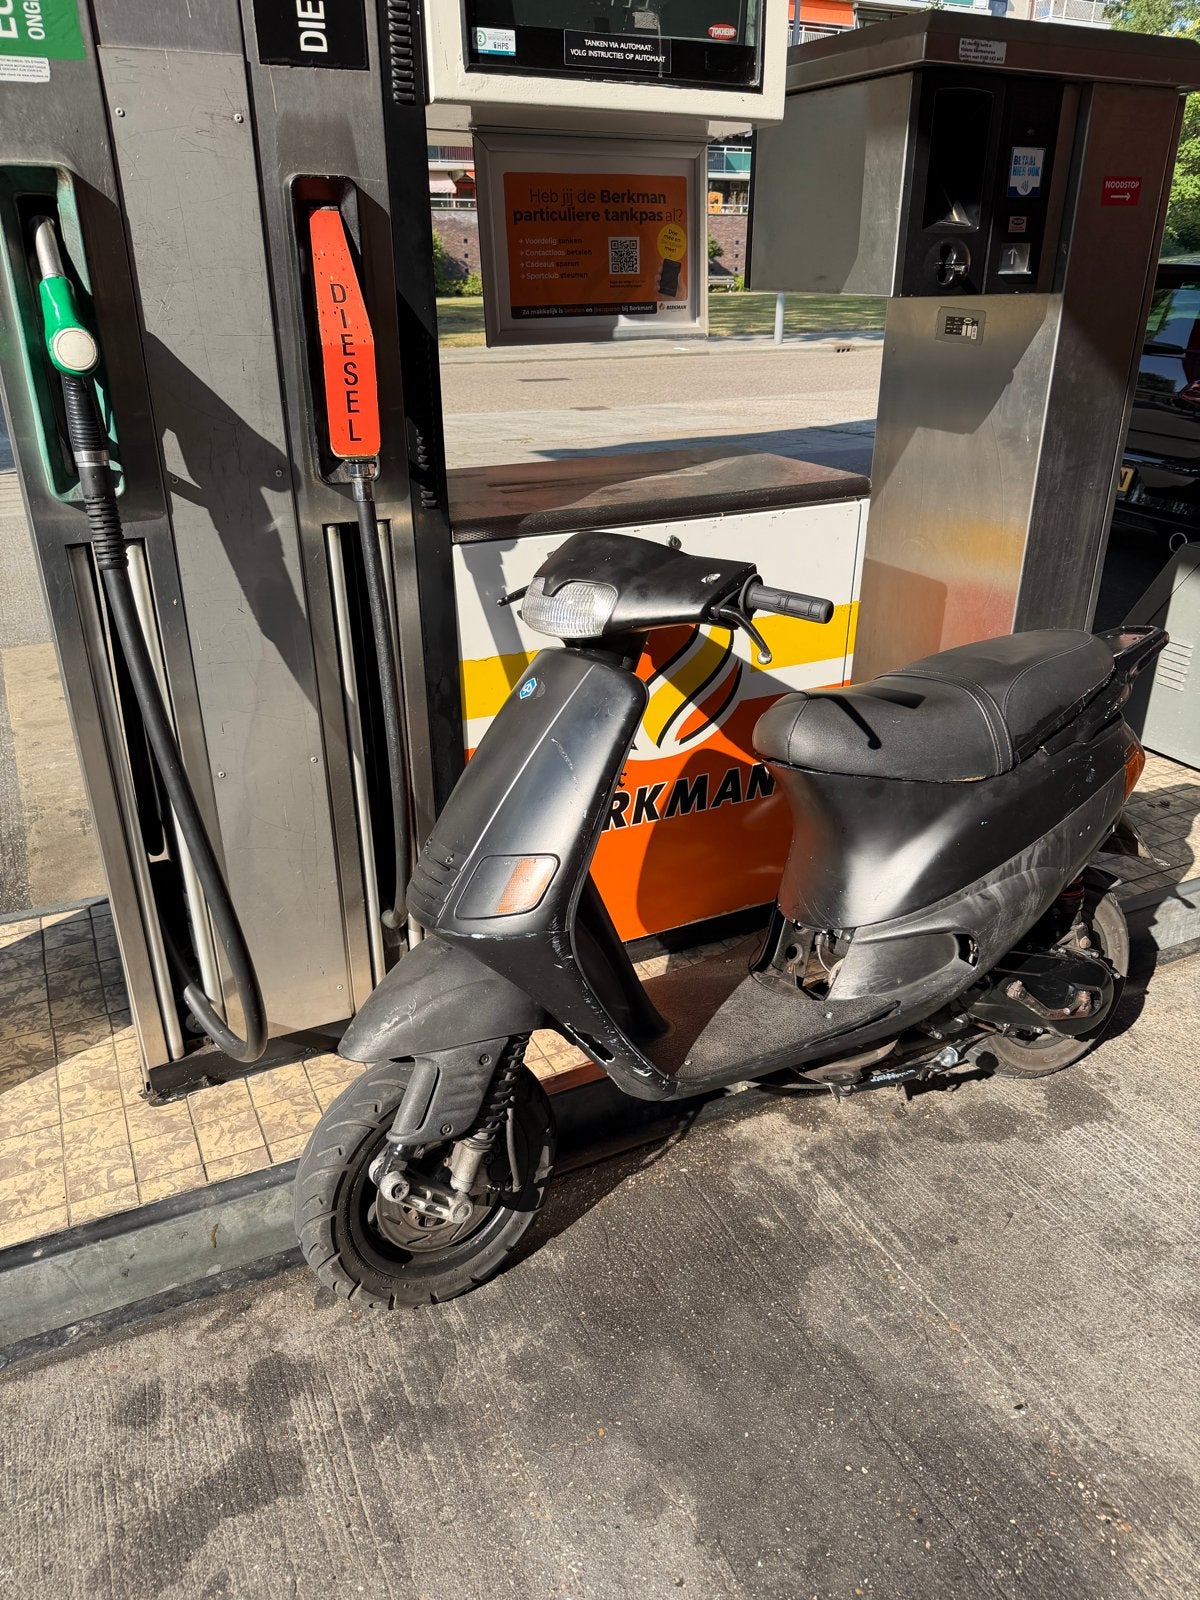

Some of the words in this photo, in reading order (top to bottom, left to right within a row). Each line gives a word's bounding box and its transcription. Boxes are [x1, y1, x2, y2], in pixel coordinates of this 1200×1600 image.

[23, 0, 45, 40] ONG
[584, 39, 609, 48] TANKEN
[570, 48, 587, 57] VOLG
[588, 50, 624, 60] INSTRUCTIES
[635, 53, 666, 63] AUTOMAAT
[1027, 166, 1041, 177] OOK
[1105, 180, 1140, 189] NOODSTOP
[529, 188, 559, 203] Heb
[562, 188, 573, 206] jij
[577, 189, 596, 203] de
[600, 189, 666, 204] Berkman
[513, 206, 601, 224] particuliere
[604, 207, 663, 224] tankpas
[665, 208, 683, 222] al?
[524, 237, 557, 245] Voordelig
[526, 272, 559, 280] Sportclub
[621, 305, 629, 313] bij
[330, 283, 363, 442] DIESEL
[601, 762, 776, 833] RKMAN
